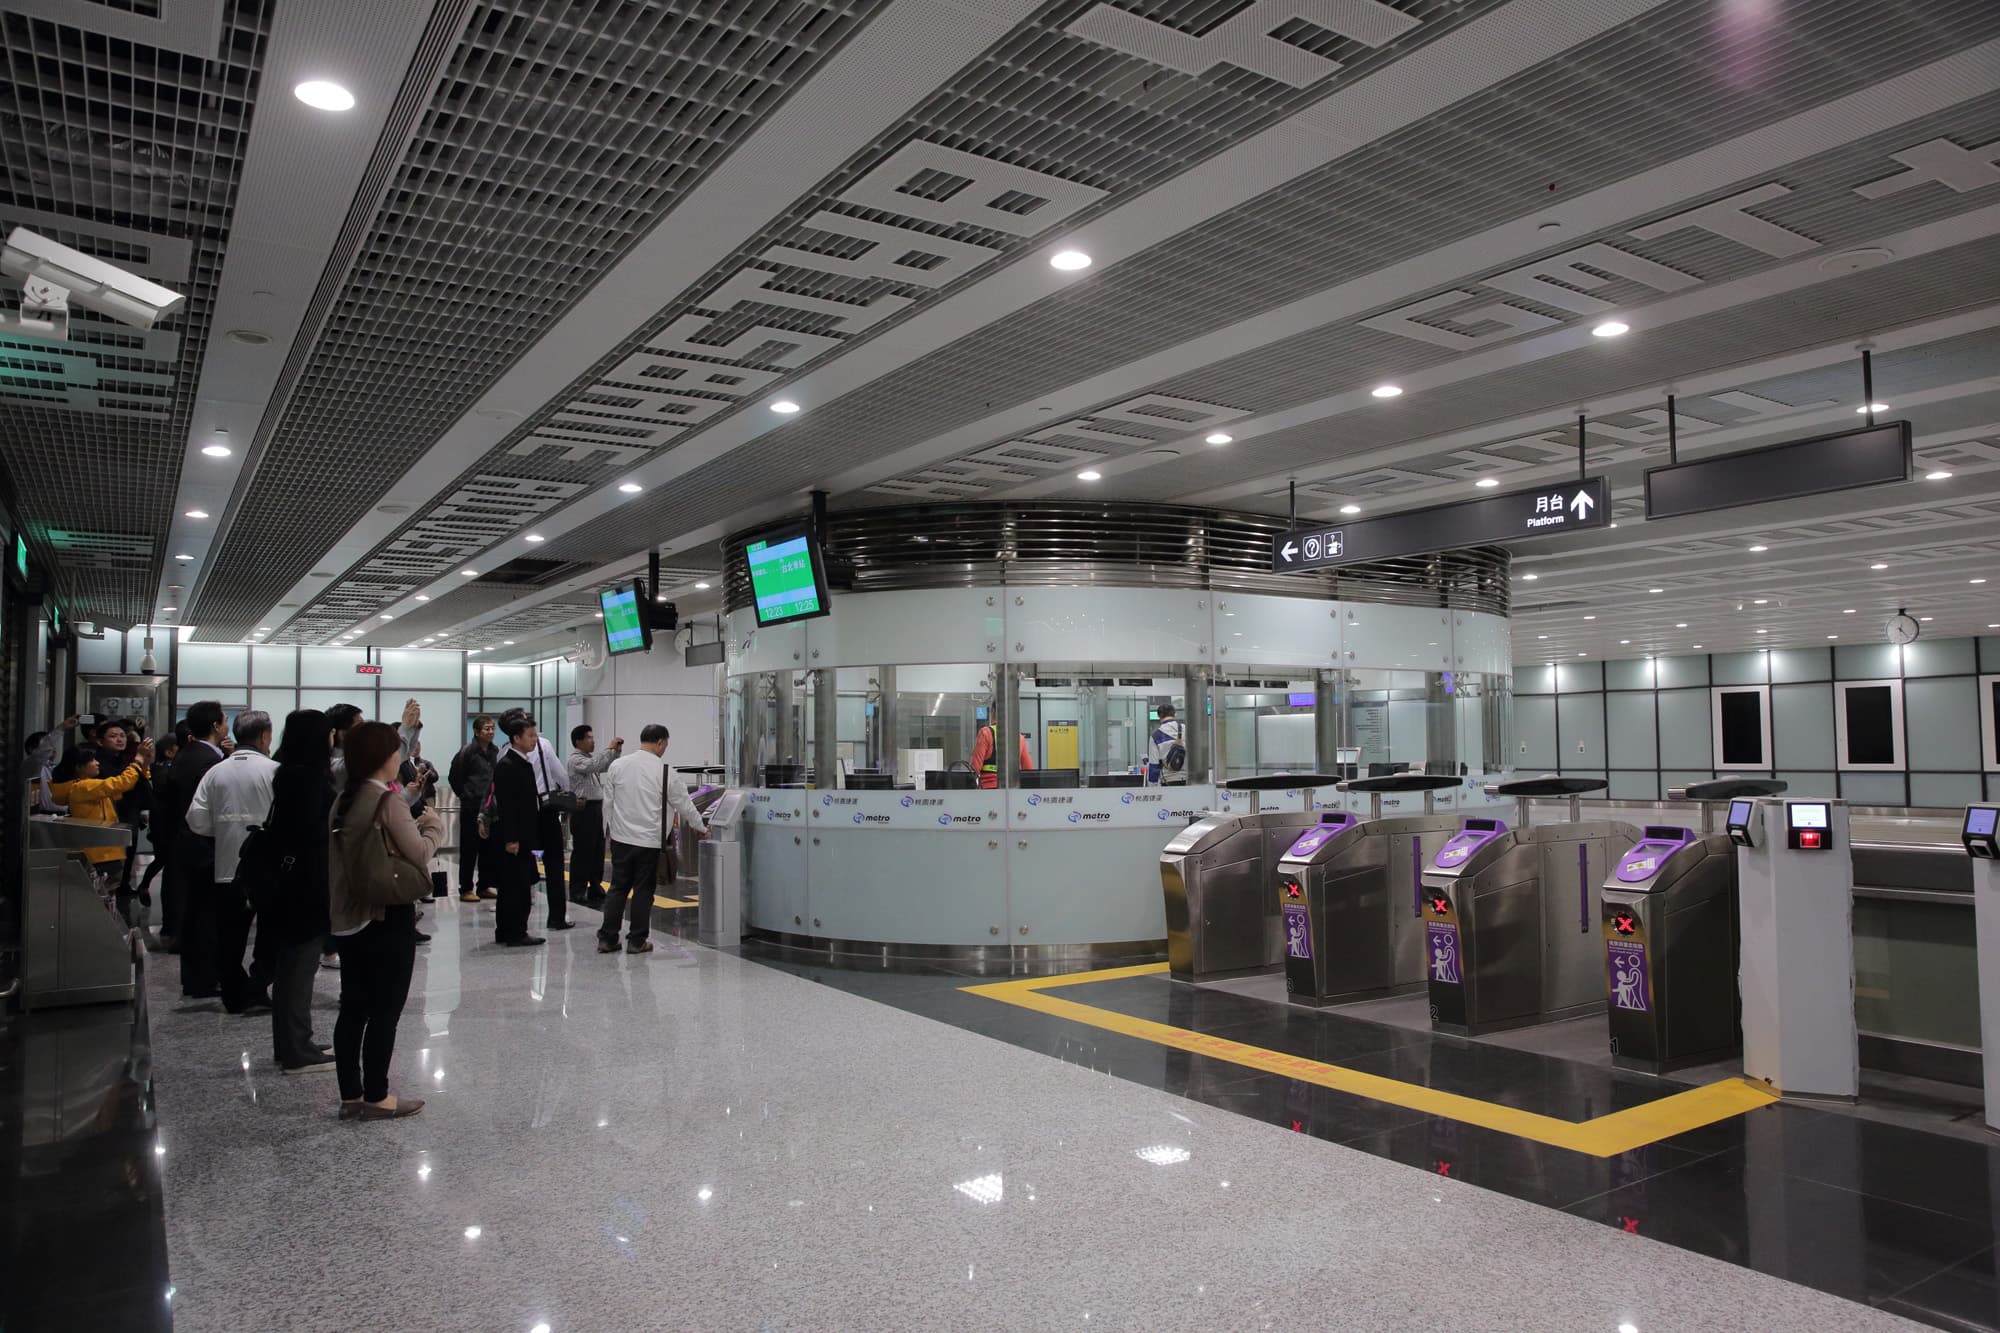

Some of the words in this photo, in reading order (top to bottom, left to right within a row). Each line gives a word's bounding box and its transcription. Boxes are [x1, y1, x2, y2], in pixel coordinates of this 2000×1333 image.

[1535, 494, 1563, 513] 月台
[1527, 516, 1564, 528] Platform
[865, 814, 890, 822] metro
[953, 814, 981, 823] metro
[1082, 812, 1111, 820] metro
[1430, 1004, 1439, 1021] 2
[1610, 1036, 1619, 1056] 1
